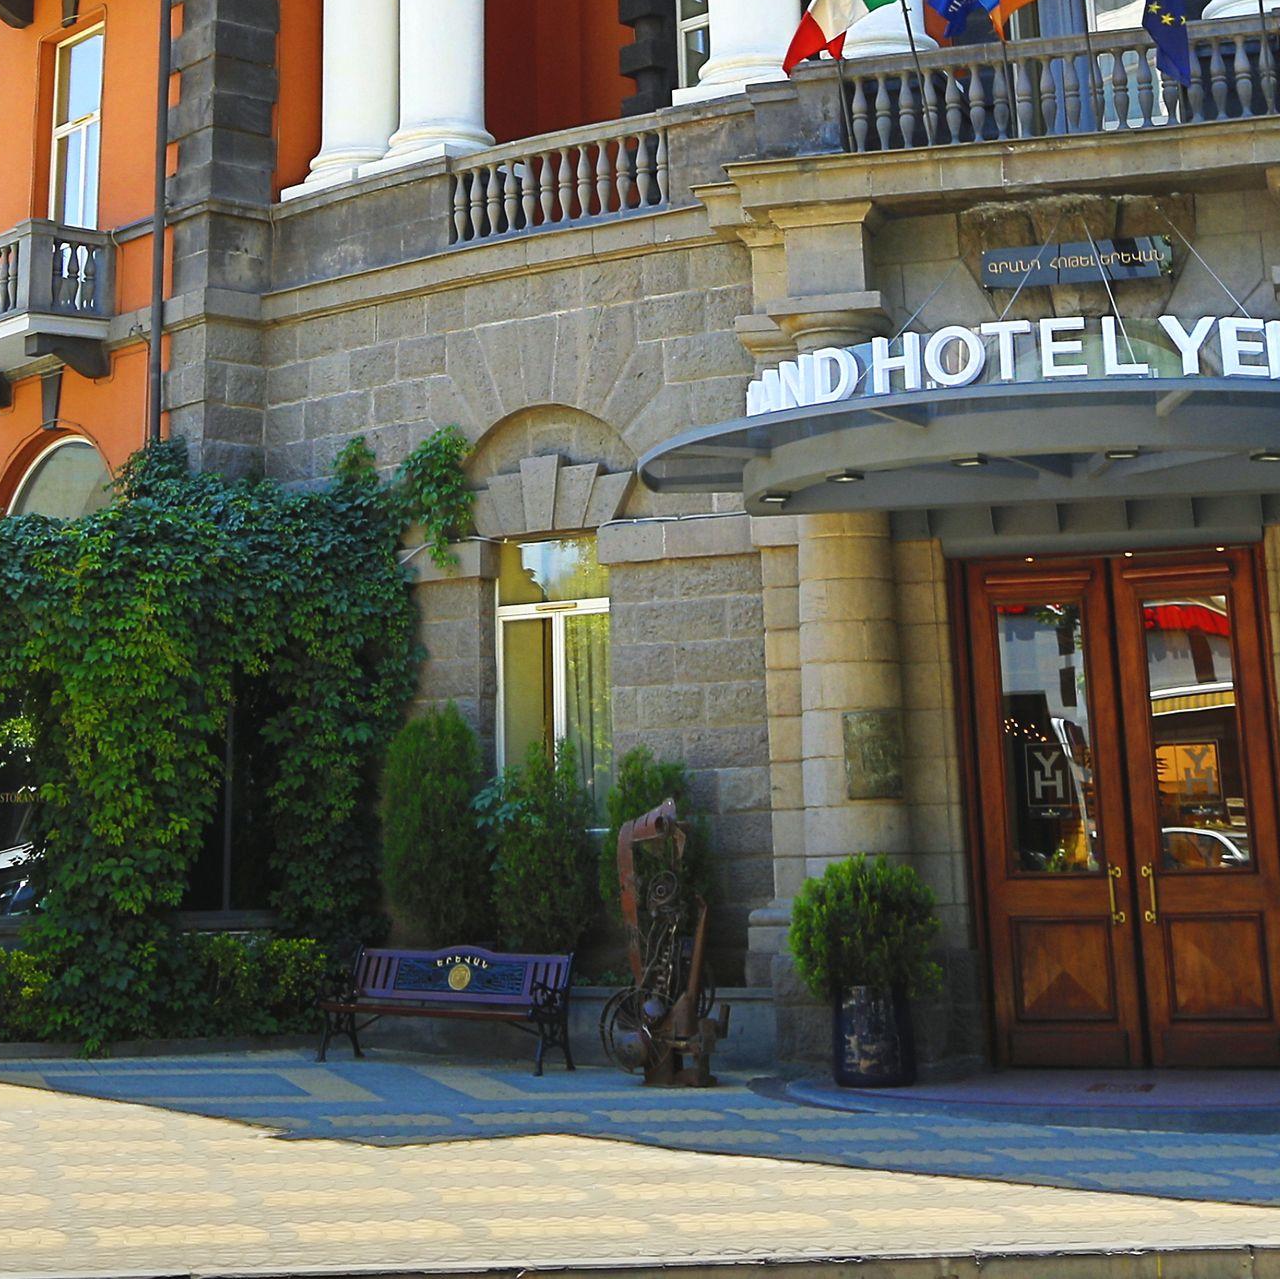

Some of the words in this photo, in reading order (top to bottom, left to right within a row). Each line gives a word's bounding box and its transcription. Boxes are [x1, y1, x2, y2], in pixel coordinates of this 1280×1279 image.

[1100, 249, 1166, 265] ԵՐԵՎԱՆ
[746, 347, 859, 417] AND
[871, 316, 1149, 395] HOTEL
